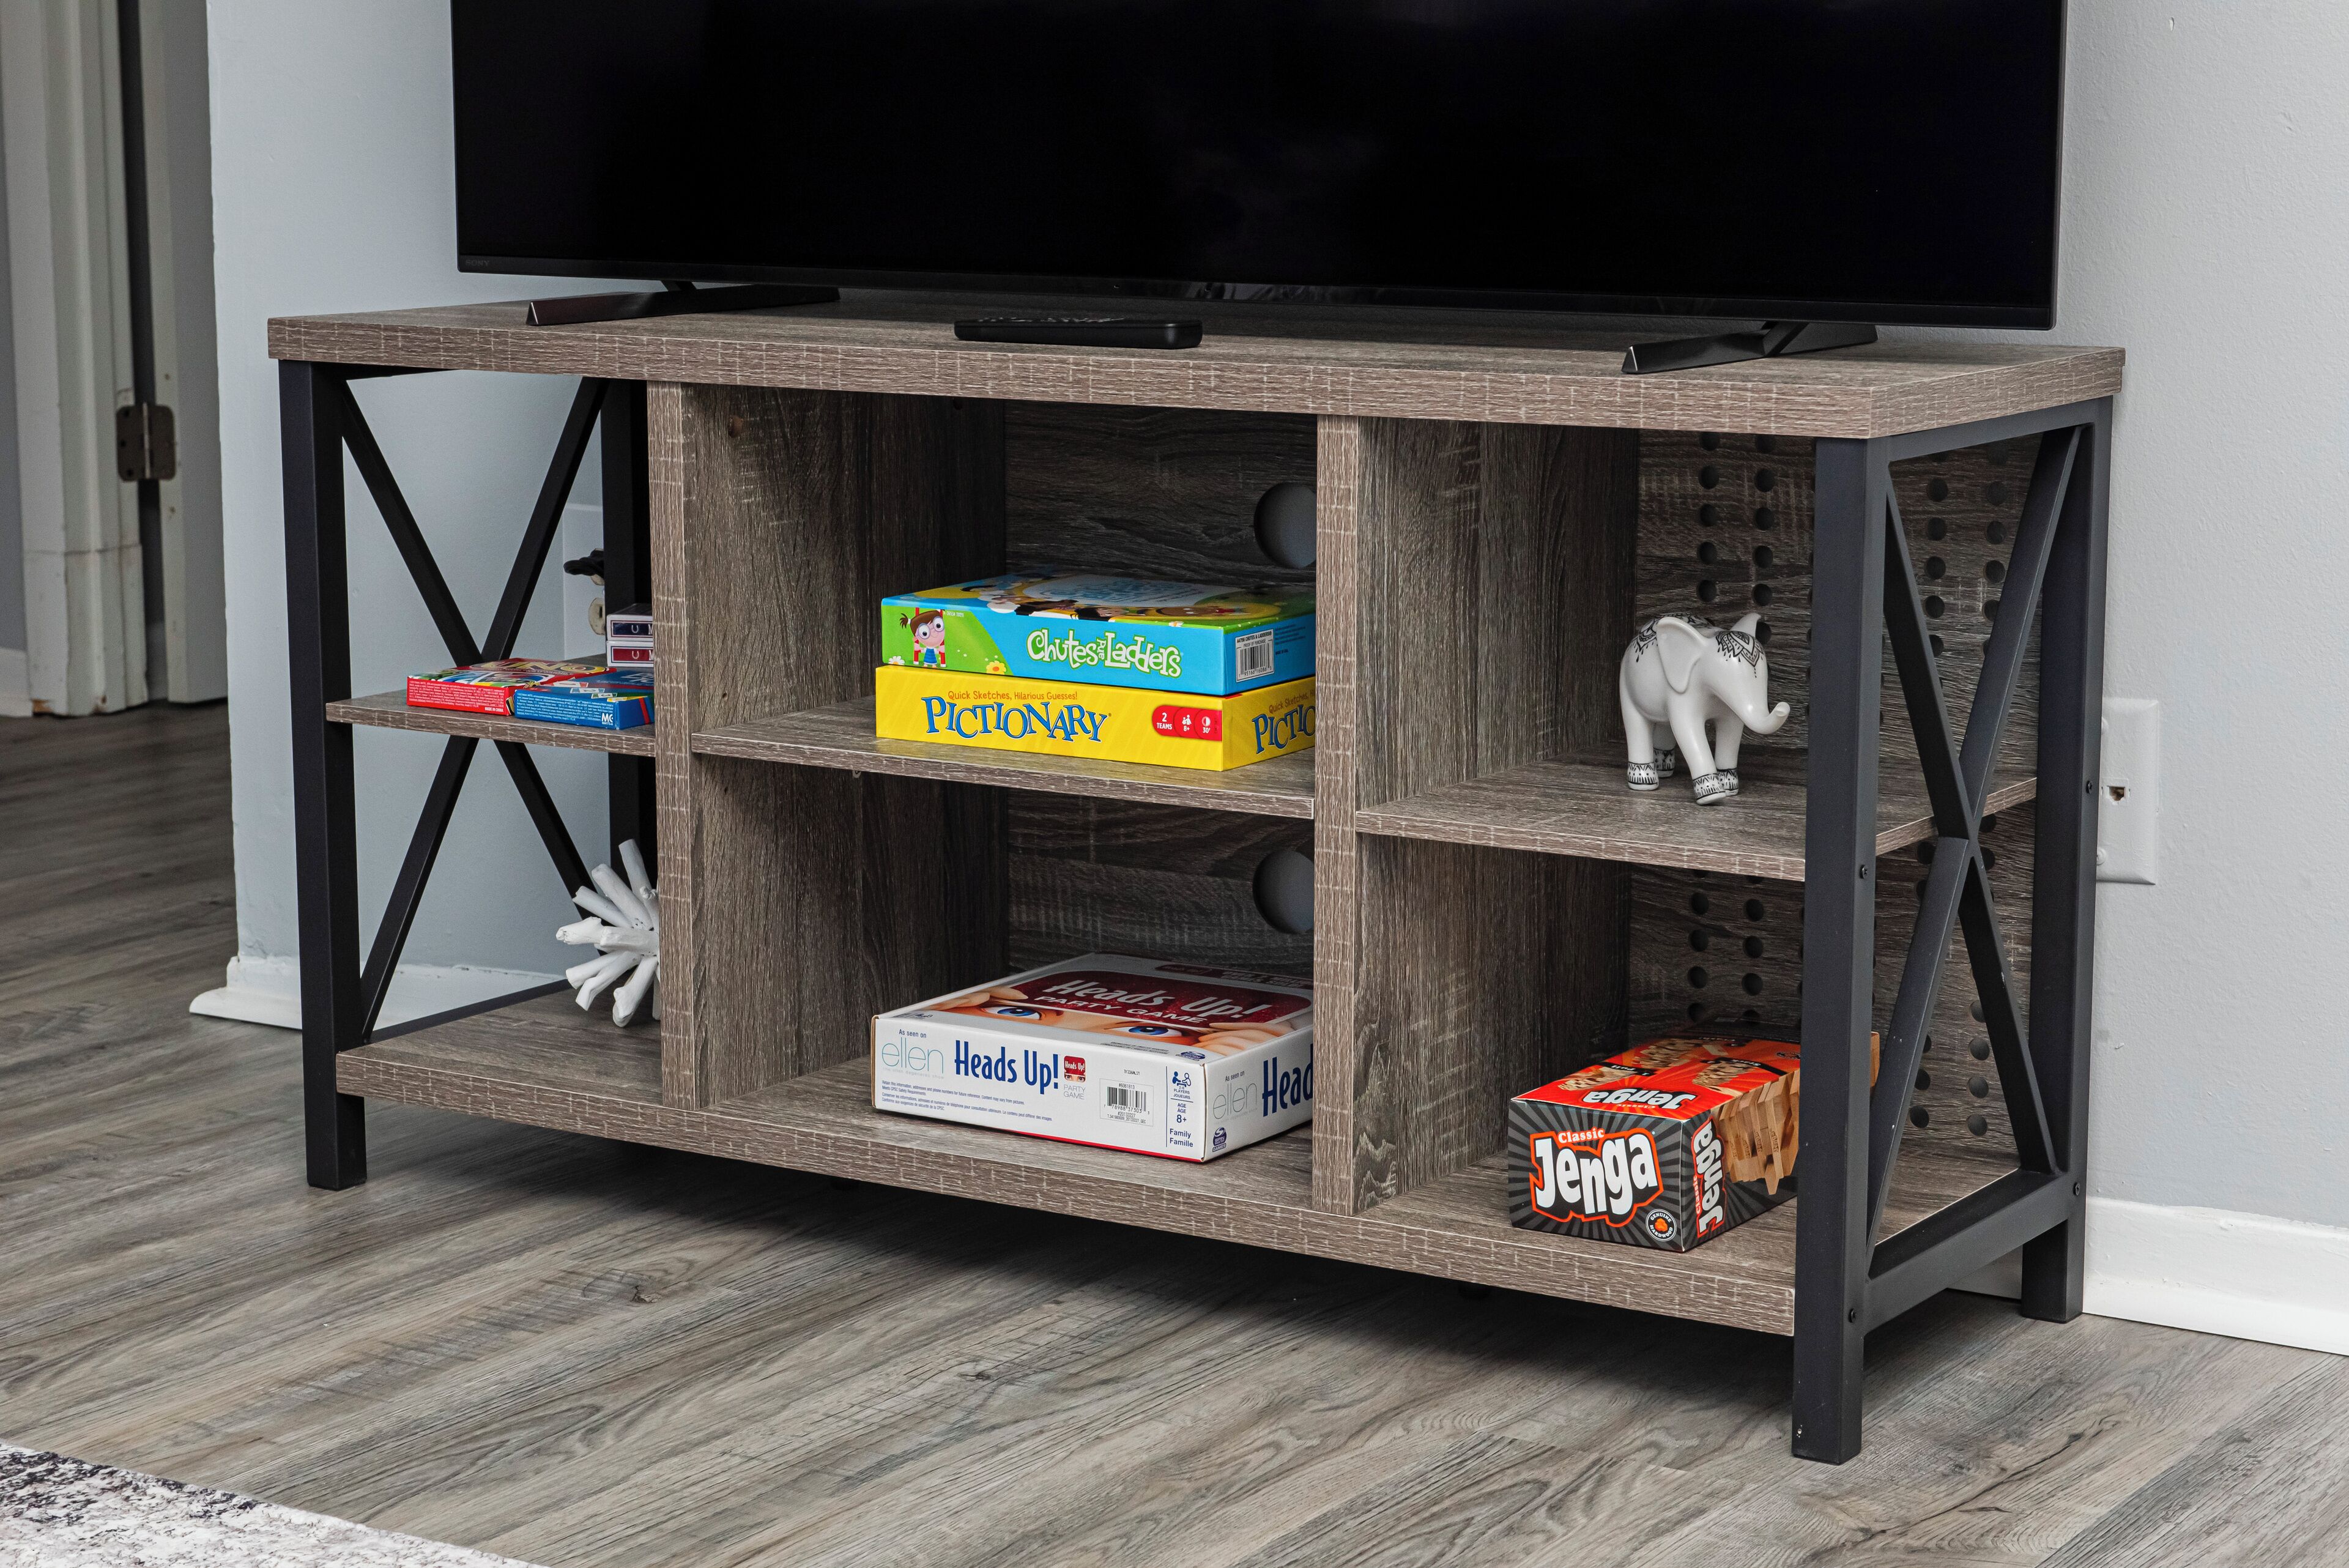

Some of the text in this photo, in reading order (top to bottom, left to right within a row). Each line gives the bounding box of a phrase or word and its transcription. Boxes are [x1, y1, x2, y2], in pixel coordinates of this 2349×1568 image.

[1028, 629, 1182, 677] Chutes and Ladders
[948, 691, 970, 700] Quick
[973, 690, 1012, 701] Sketches,
[1047, 691, 1078, 700] Guesses!
[1269, 701, 1283, 713] Quick
[921, 696, 1108, 741] PICTIONARY
[1162, 712, 1167, 722] 2
[1042, 980, 1272, 1019] Heads Up!
[1034, 996, 1208, 1024] PARTY GAME
[881, 1037, 944, 1074] ellen
[954, 1040, 1059, 1095] Heads Up!
[1065, 1061, 1077, 1069] Heads
[1064, 1084, 1086, 1093] PARTY
[1064, 1091, 1085, 1100] GAME
[1213, 1083, 1258, 1120] ellen
[1583, 1088, 1696, 1109] Jenga
[1176, 1114, 1187, 1123] 8+
[1170, 1128, 1191, 1139] Family
[1558, 1128, 1605, 1143] Classic
[1170, 1137, 1193, 1147] Famille
[1535, 1134, 1658, 1215] Jenga
[1693, 1121, 1723, 1233] Jenga
[1650, 1213, 1672, 1222] GENUINE
[1649, 1225, 1673, 1238] HARDWOOD
